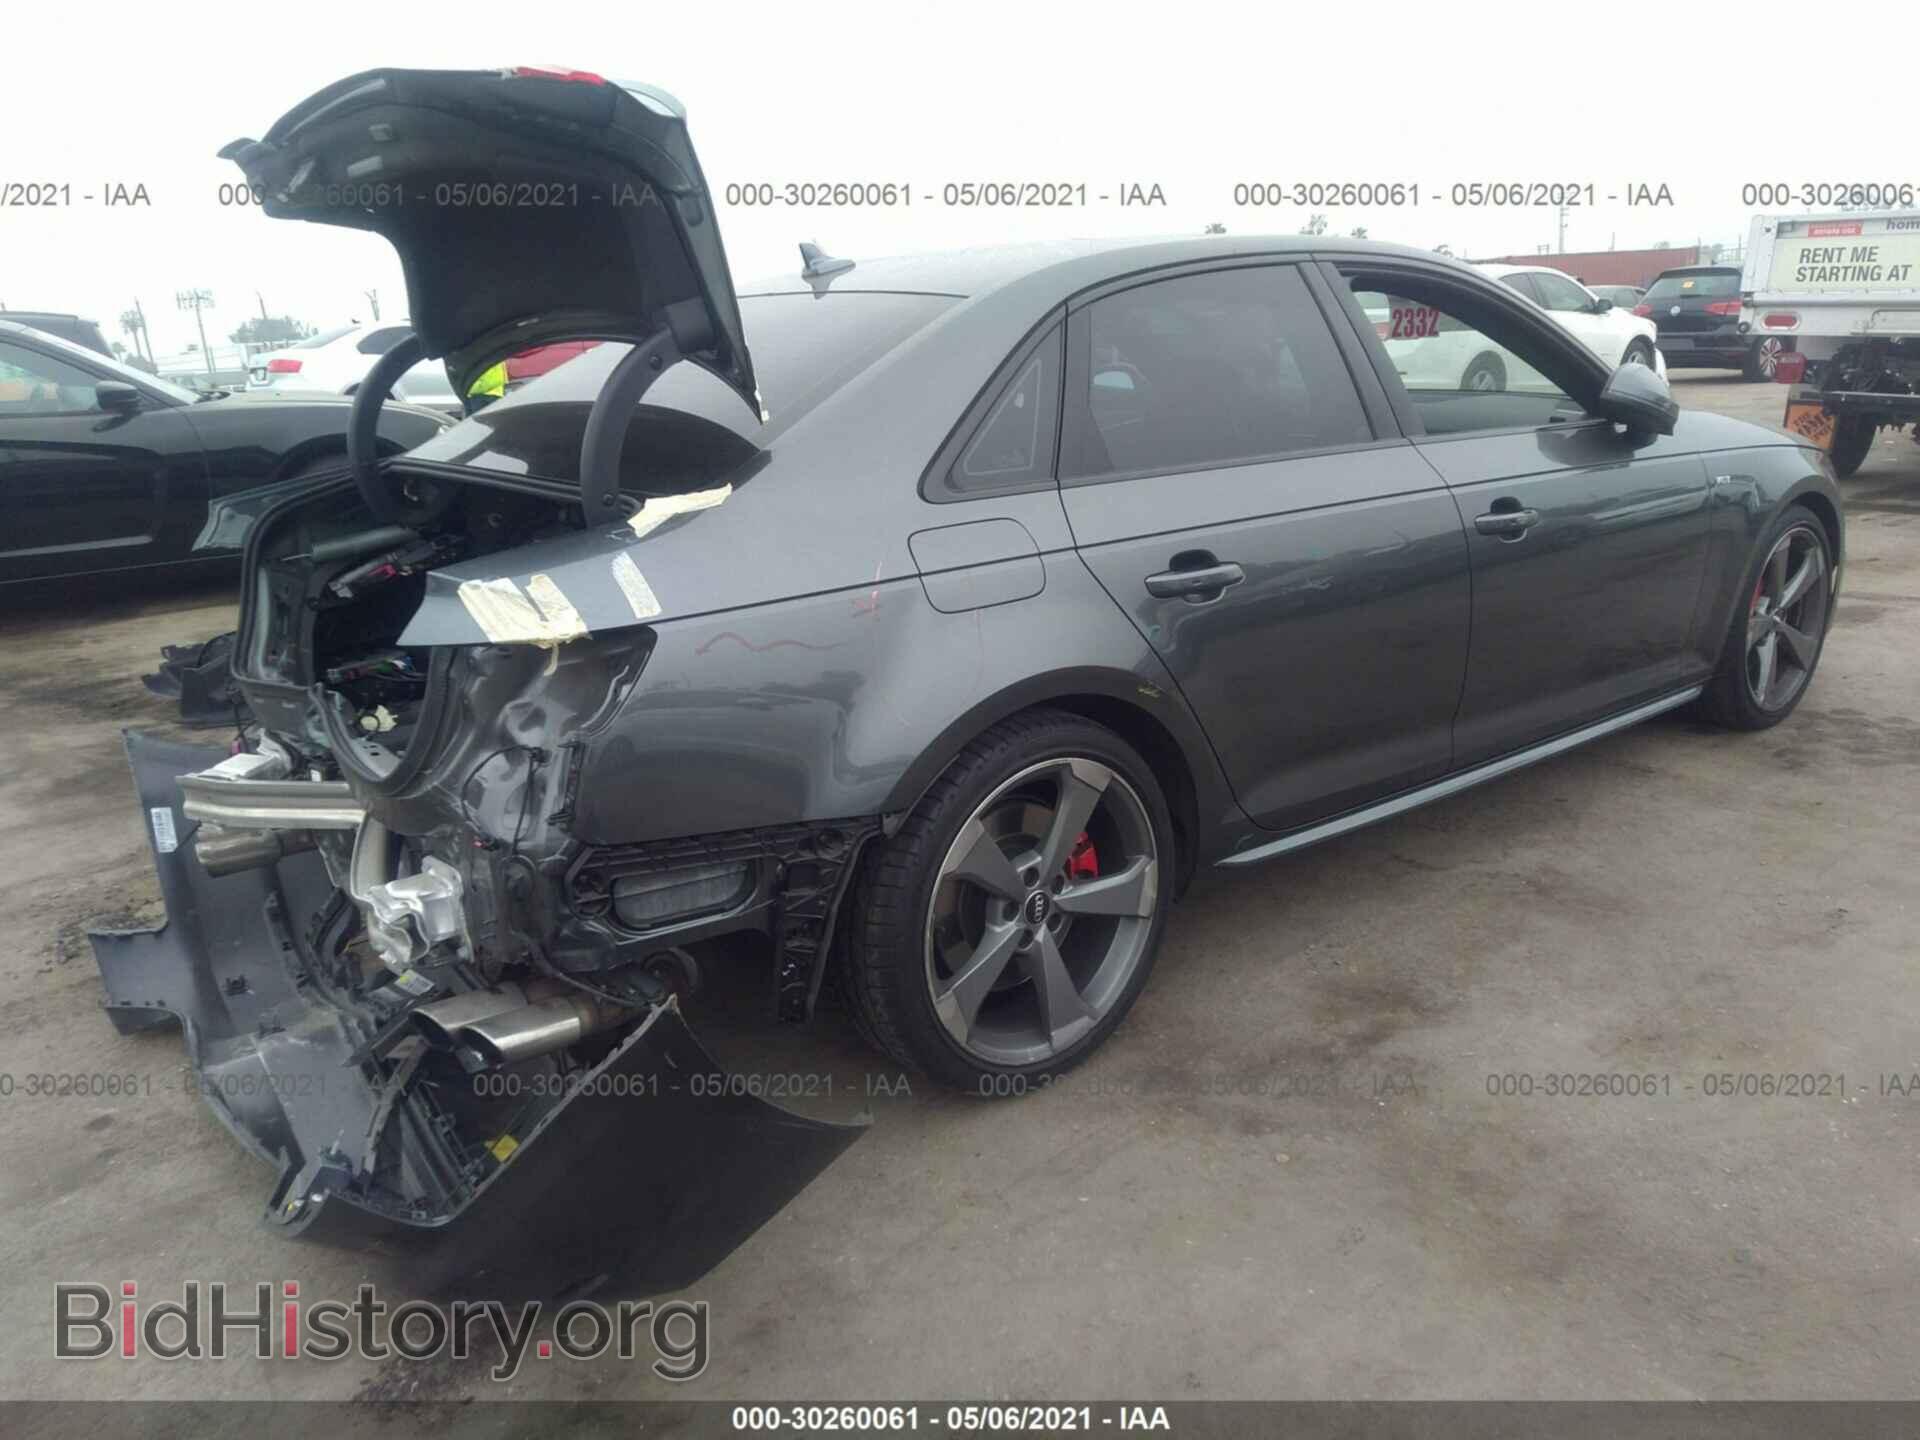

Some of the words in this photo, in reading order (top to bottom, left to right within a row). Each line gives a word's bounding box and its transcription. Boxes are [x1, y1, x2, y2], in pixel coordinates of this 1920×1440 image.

[1799, 247, 1846, 264] RENT
[1850, 246, 1880, 263] ME
[1795, 265, 1882, 282] STARTING
[1887, 264, 1912, 281] AT
[1392, 306, 1441, 338] 2332
